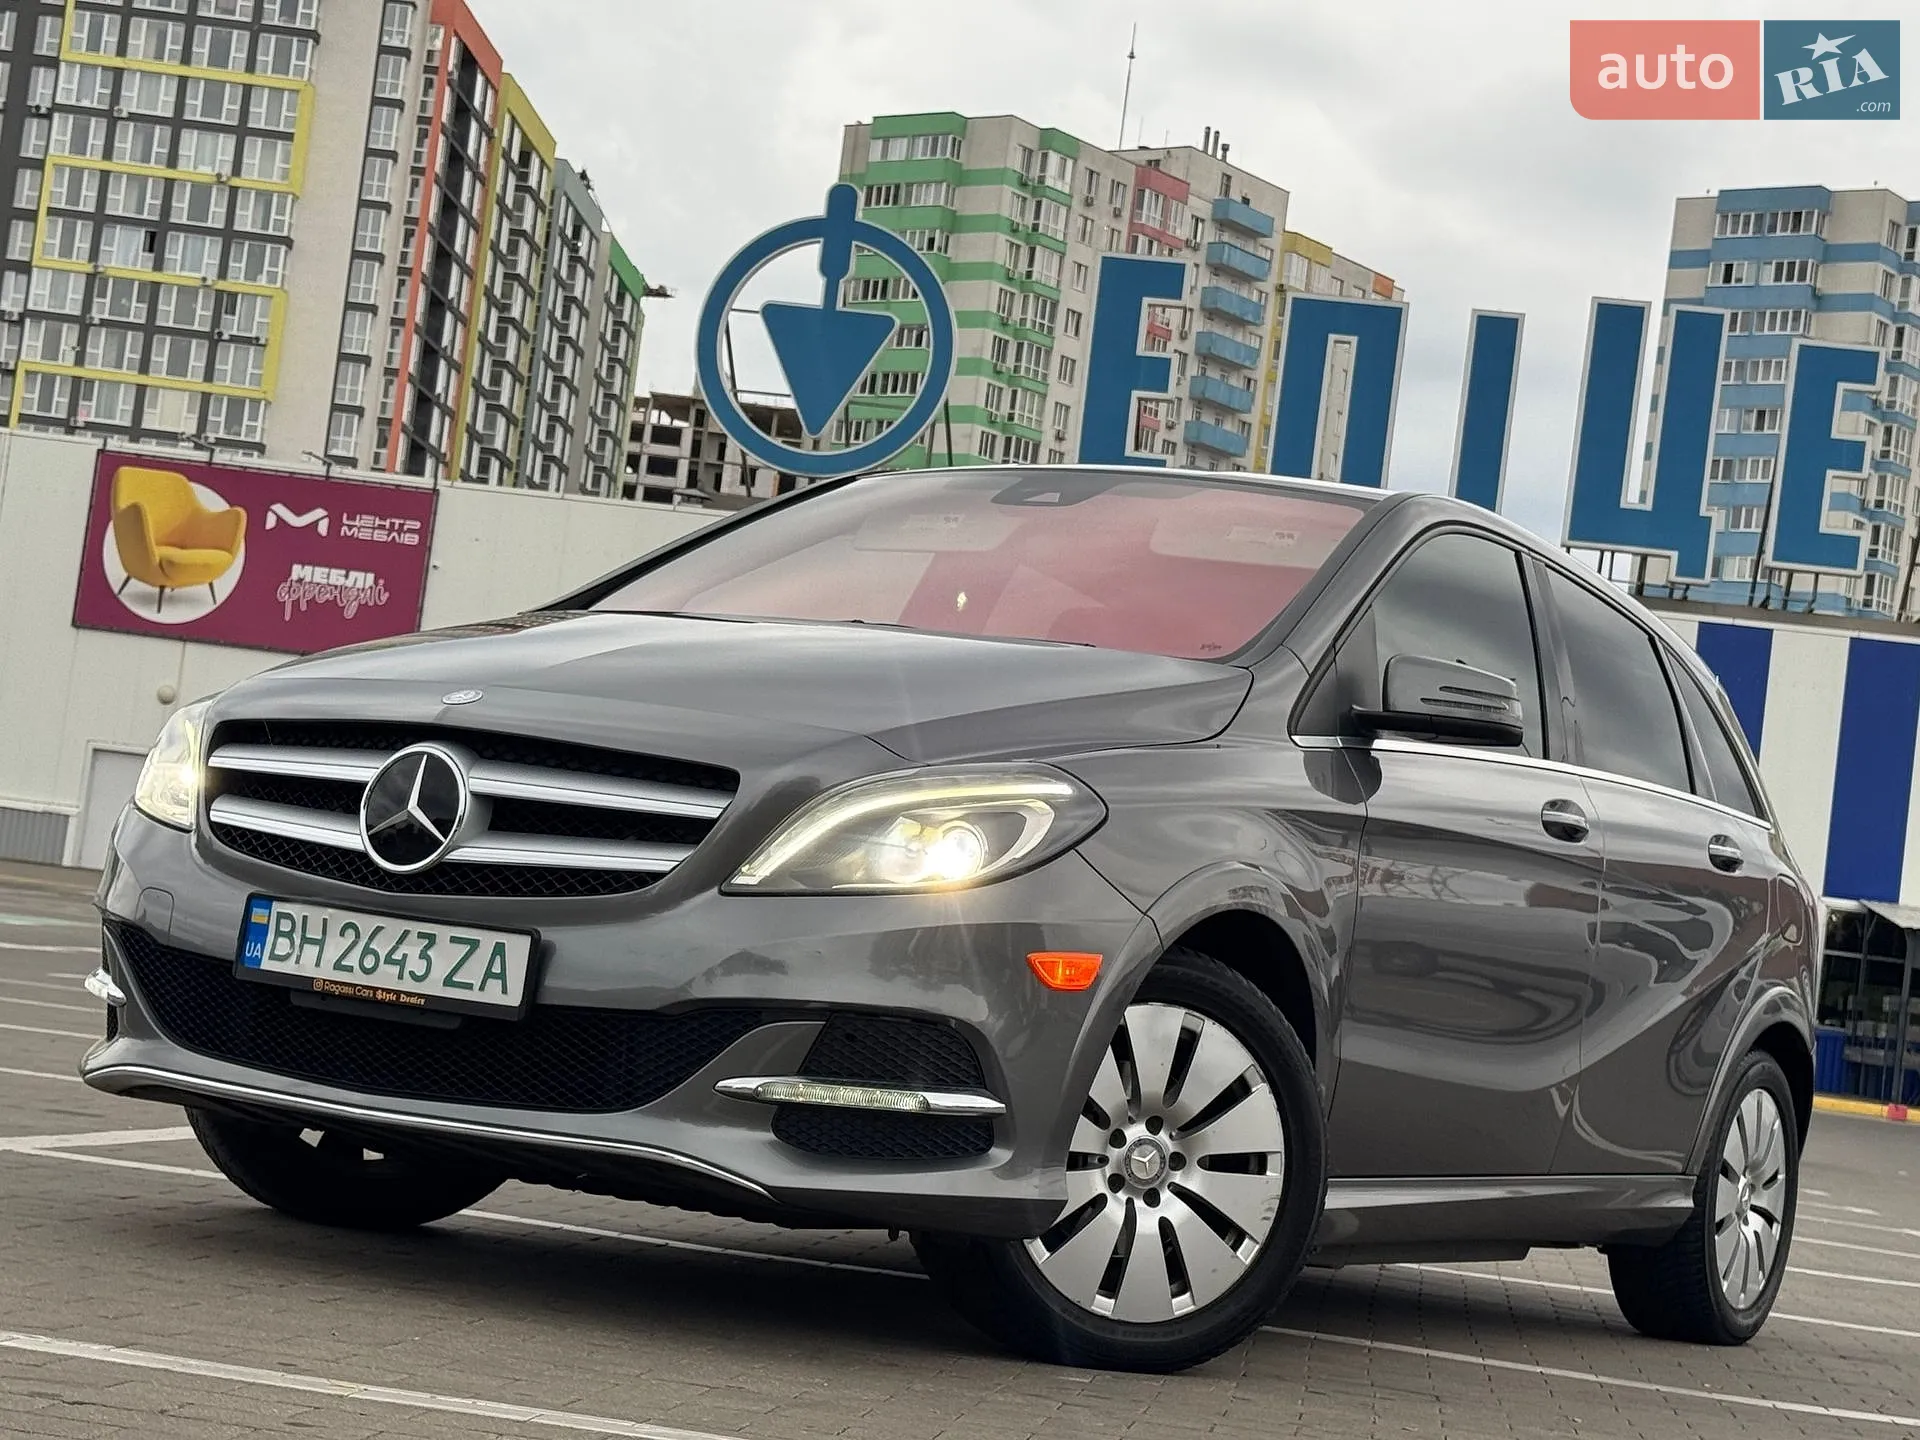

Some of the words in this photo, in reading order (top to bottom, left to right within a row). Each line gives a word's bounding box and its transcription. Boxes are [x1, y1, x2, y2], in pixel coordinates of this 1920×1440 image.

[342, 512, 421, 530] ЦЕНТР
[340, 527, 420, 545] МЕБЛІВ
[291, 563, 376, 589] МЕБЛІ
[245, 940, 263, 959] UA
[268, 911, 329, 968] BH
[333, 920, 437, 983] 2643
[442, 935, 509, 995] ZA
[355, 986, 374, 998] Cars
